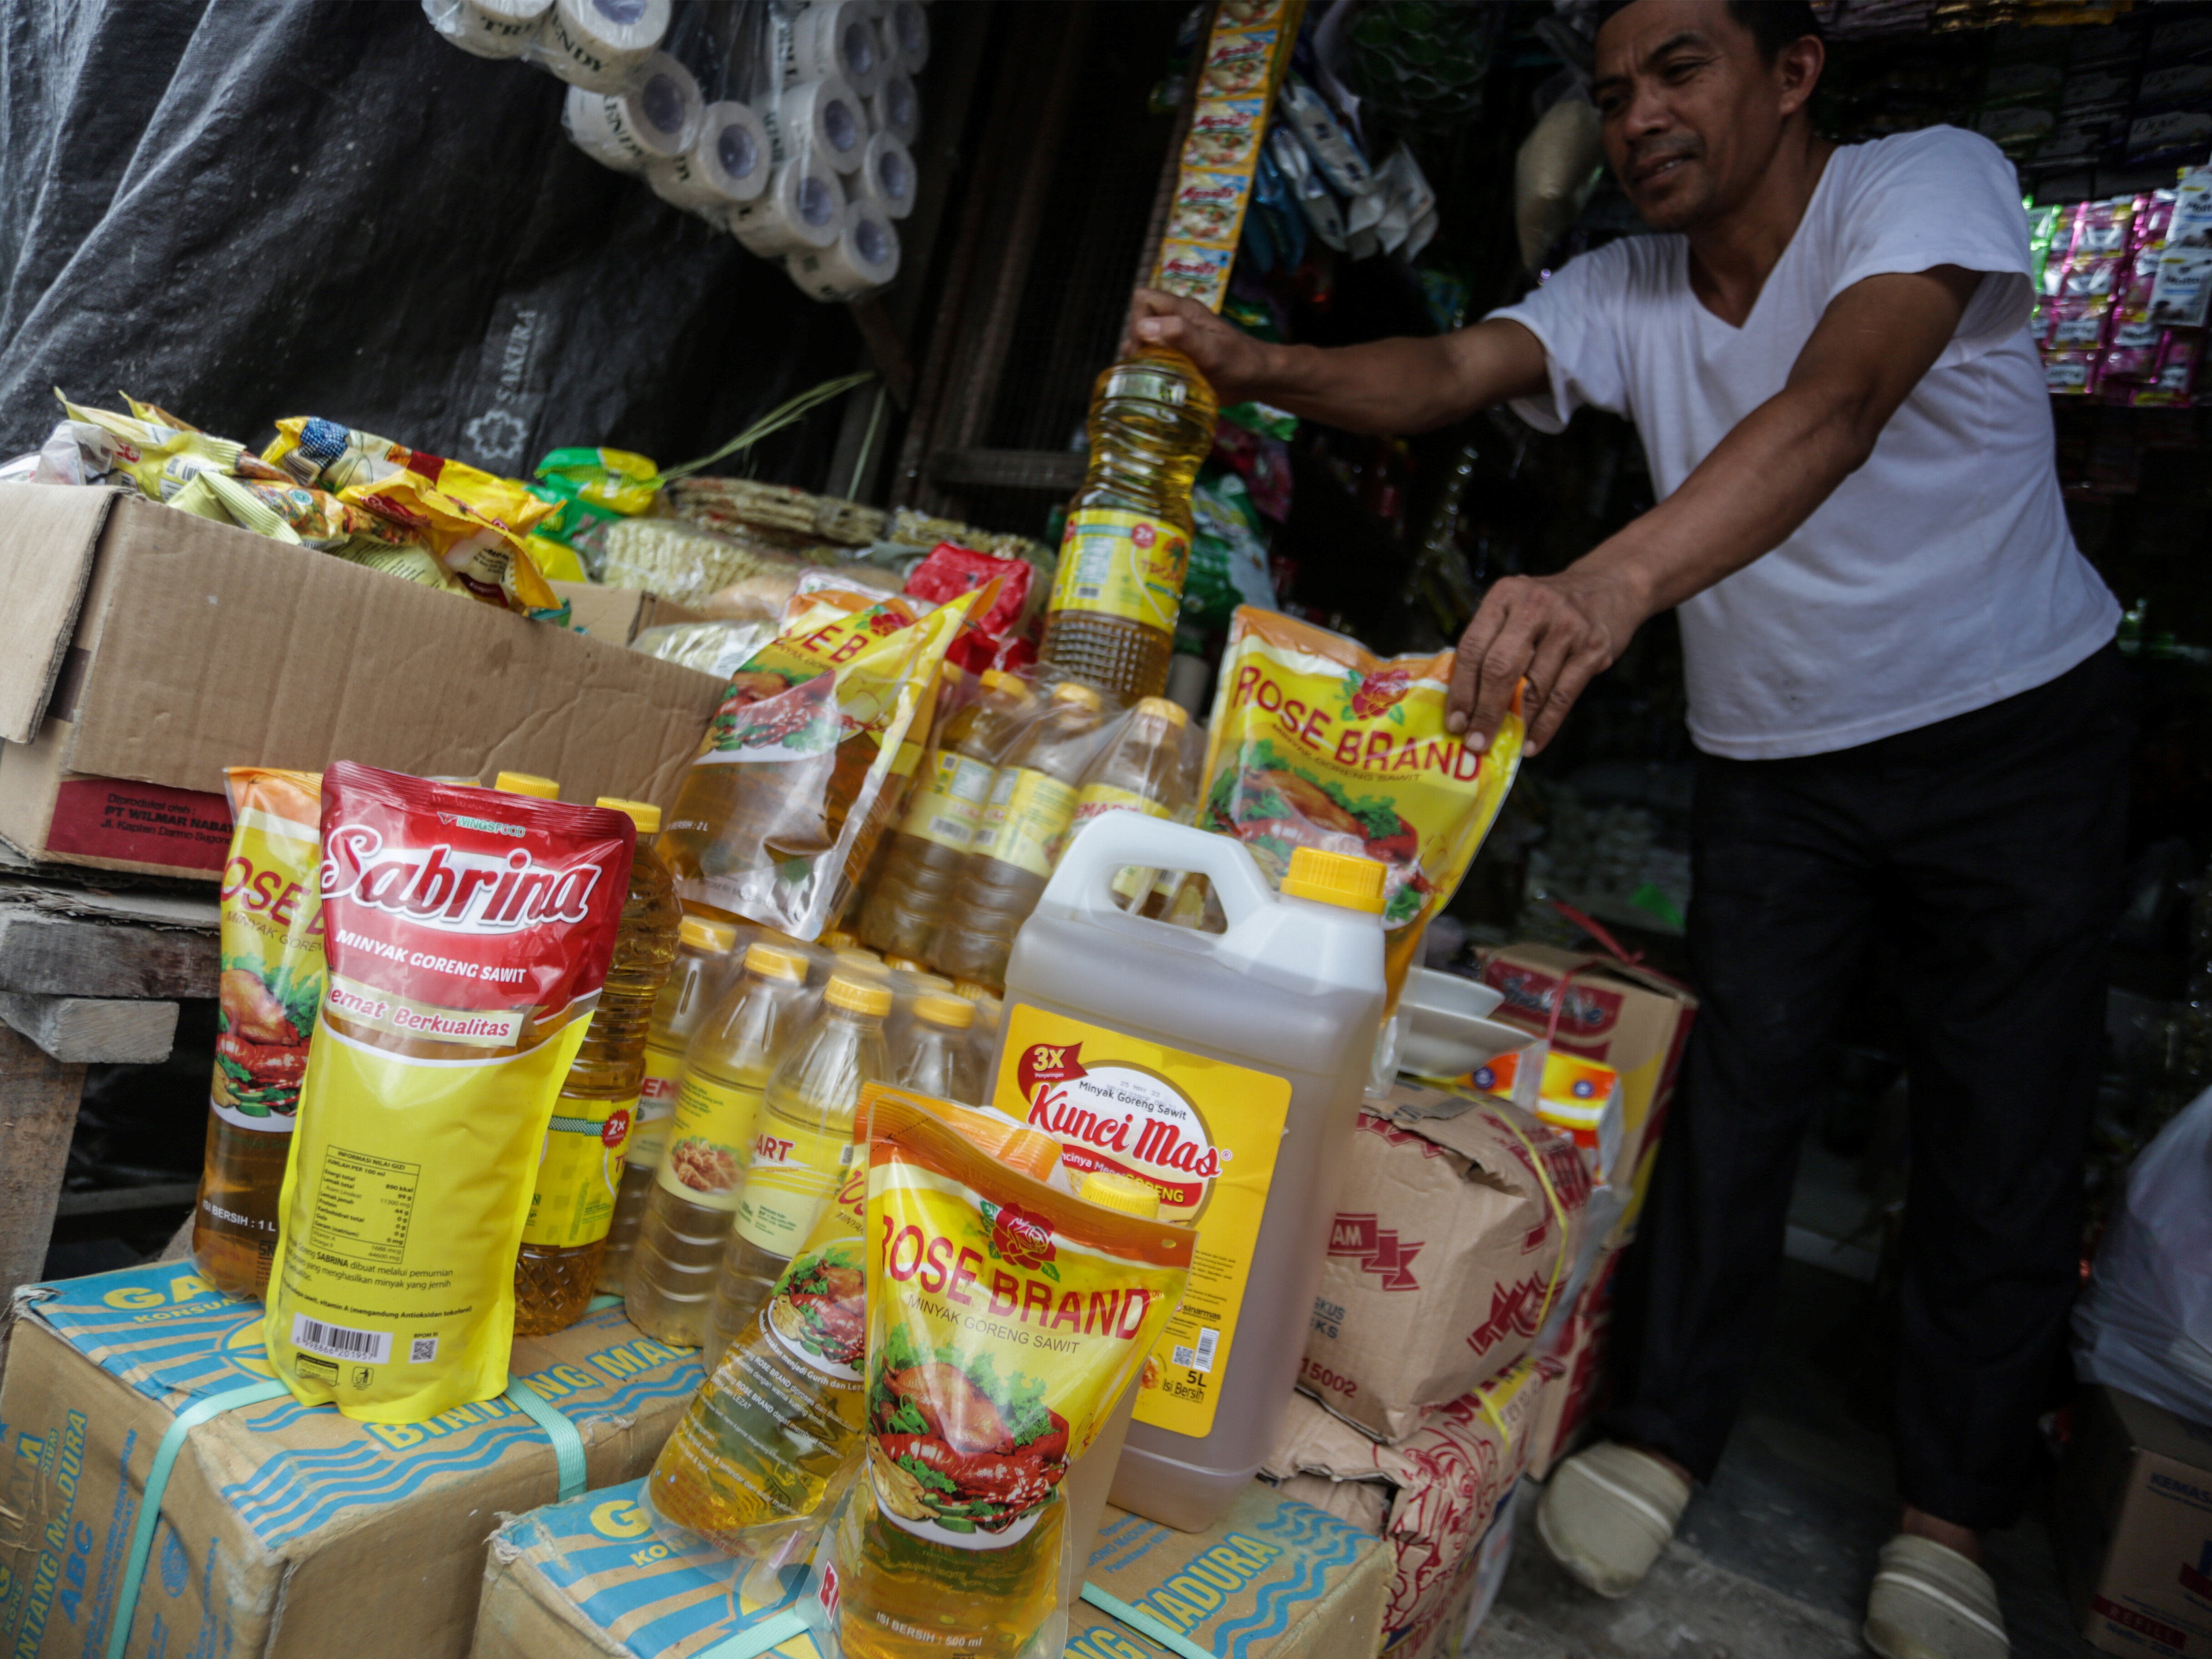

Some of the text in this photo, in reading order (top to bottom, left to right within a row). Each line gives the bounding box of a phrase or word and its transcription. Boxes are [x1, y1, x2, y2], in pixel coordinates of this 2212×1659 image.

[1231, 666, 1482, 782] ROSE BRAND
[1312, 756, 1373, 782] GORENG
[1377, 773, 1421, 783] SAWIT
[107, 792, 166, 810] Diproduksi
[104, 806, 235, 834] PT WILMAR NABAT
[117, 821, 156, 834] Kapten
[158, 827, 193, 840] Darmo
[320, 824, 602, 927] Sabrina
[226, 910, 277, 940] MINYAK
[335, 929, 527, 984] MINYAK GORENG SAWIT
[394, 1007, 510, 1037] Berkualitas
[1079, 1080, 1187, 1121] Minyak Goreng Sawit
[1026, 1082, 1223, 1179] Kunci Mas
[327, 1159, 350, 1170] JUMLAH
[338, 1150, 372, 1163] INFORMASI
[372, 1159, 390, 1167] NILAI
[323, 1176, 340, 1186] Lemak
[341, 1181, 354, 1189] total
[342, 1174, 356, 1182] total
[319, 1198, 337, 1208] Protein
[320, 1191, 337, 1201] Lemak
[211, 1205, 248, 1226] BERSIH
[350, 1215, 365, 1223] total
[306, 1262, 321, 1274] yang
[322, 1267, 373, 1285] menghasilkan
[375, 1278, 404, 1289] minyak
[406, 1281, 427, 1291] yang
[428, 1280, 451, 1291] jernih
[317, 1251, 453, 1278] SABRINA dibuat melalui pemurnian
[319, 1300, 343, 1311] vitamin
[350, 1306, 400, 1320] (mengandung
[444, 1305, 473, 1317] tokoferol)
[988, 1273, 1151, 1340] BRAND
[1182, 1304, 1222, 1321] sinarmas
[906, 1294, 1081, 1355] MINYAK GORENG SAWIT
[764, 1333, 783, 1358] masakan
[781, 1355, 807, 1376] menjadi
[806, 1371, 829, 1386] Gurih
[829, 1380, 846, 1390] dan
[755, 1357, 770, 1373] ROSE
[769, 1367, 792, 1388] BRAND
[790, 1384, 816, 1406] diproses
[1186, 1370, 1207, 1388] 5L
[1300, 1357, 1358, 1398] 15002
[732, 1394, 752, 1410] LEZAT
[753, 1371, 772, 1390] dengan
[788, 1397, 809, 1417] kuning
[1174, 1383, 1205, 1402] Bersih
[736, 1380, 752, 1397] ROSE
[751, 1393, 774, 1414] BRAND
[773, 1409, 791, 1427] dapat
[789, 1422, 820, 1445] membuat
[2151, 1471, 2212, 1504] KEMAS
[60, 1520, 94, 1625] ABC
[876, 1610, 983, 1647] ISI BERSIH 500 ml
